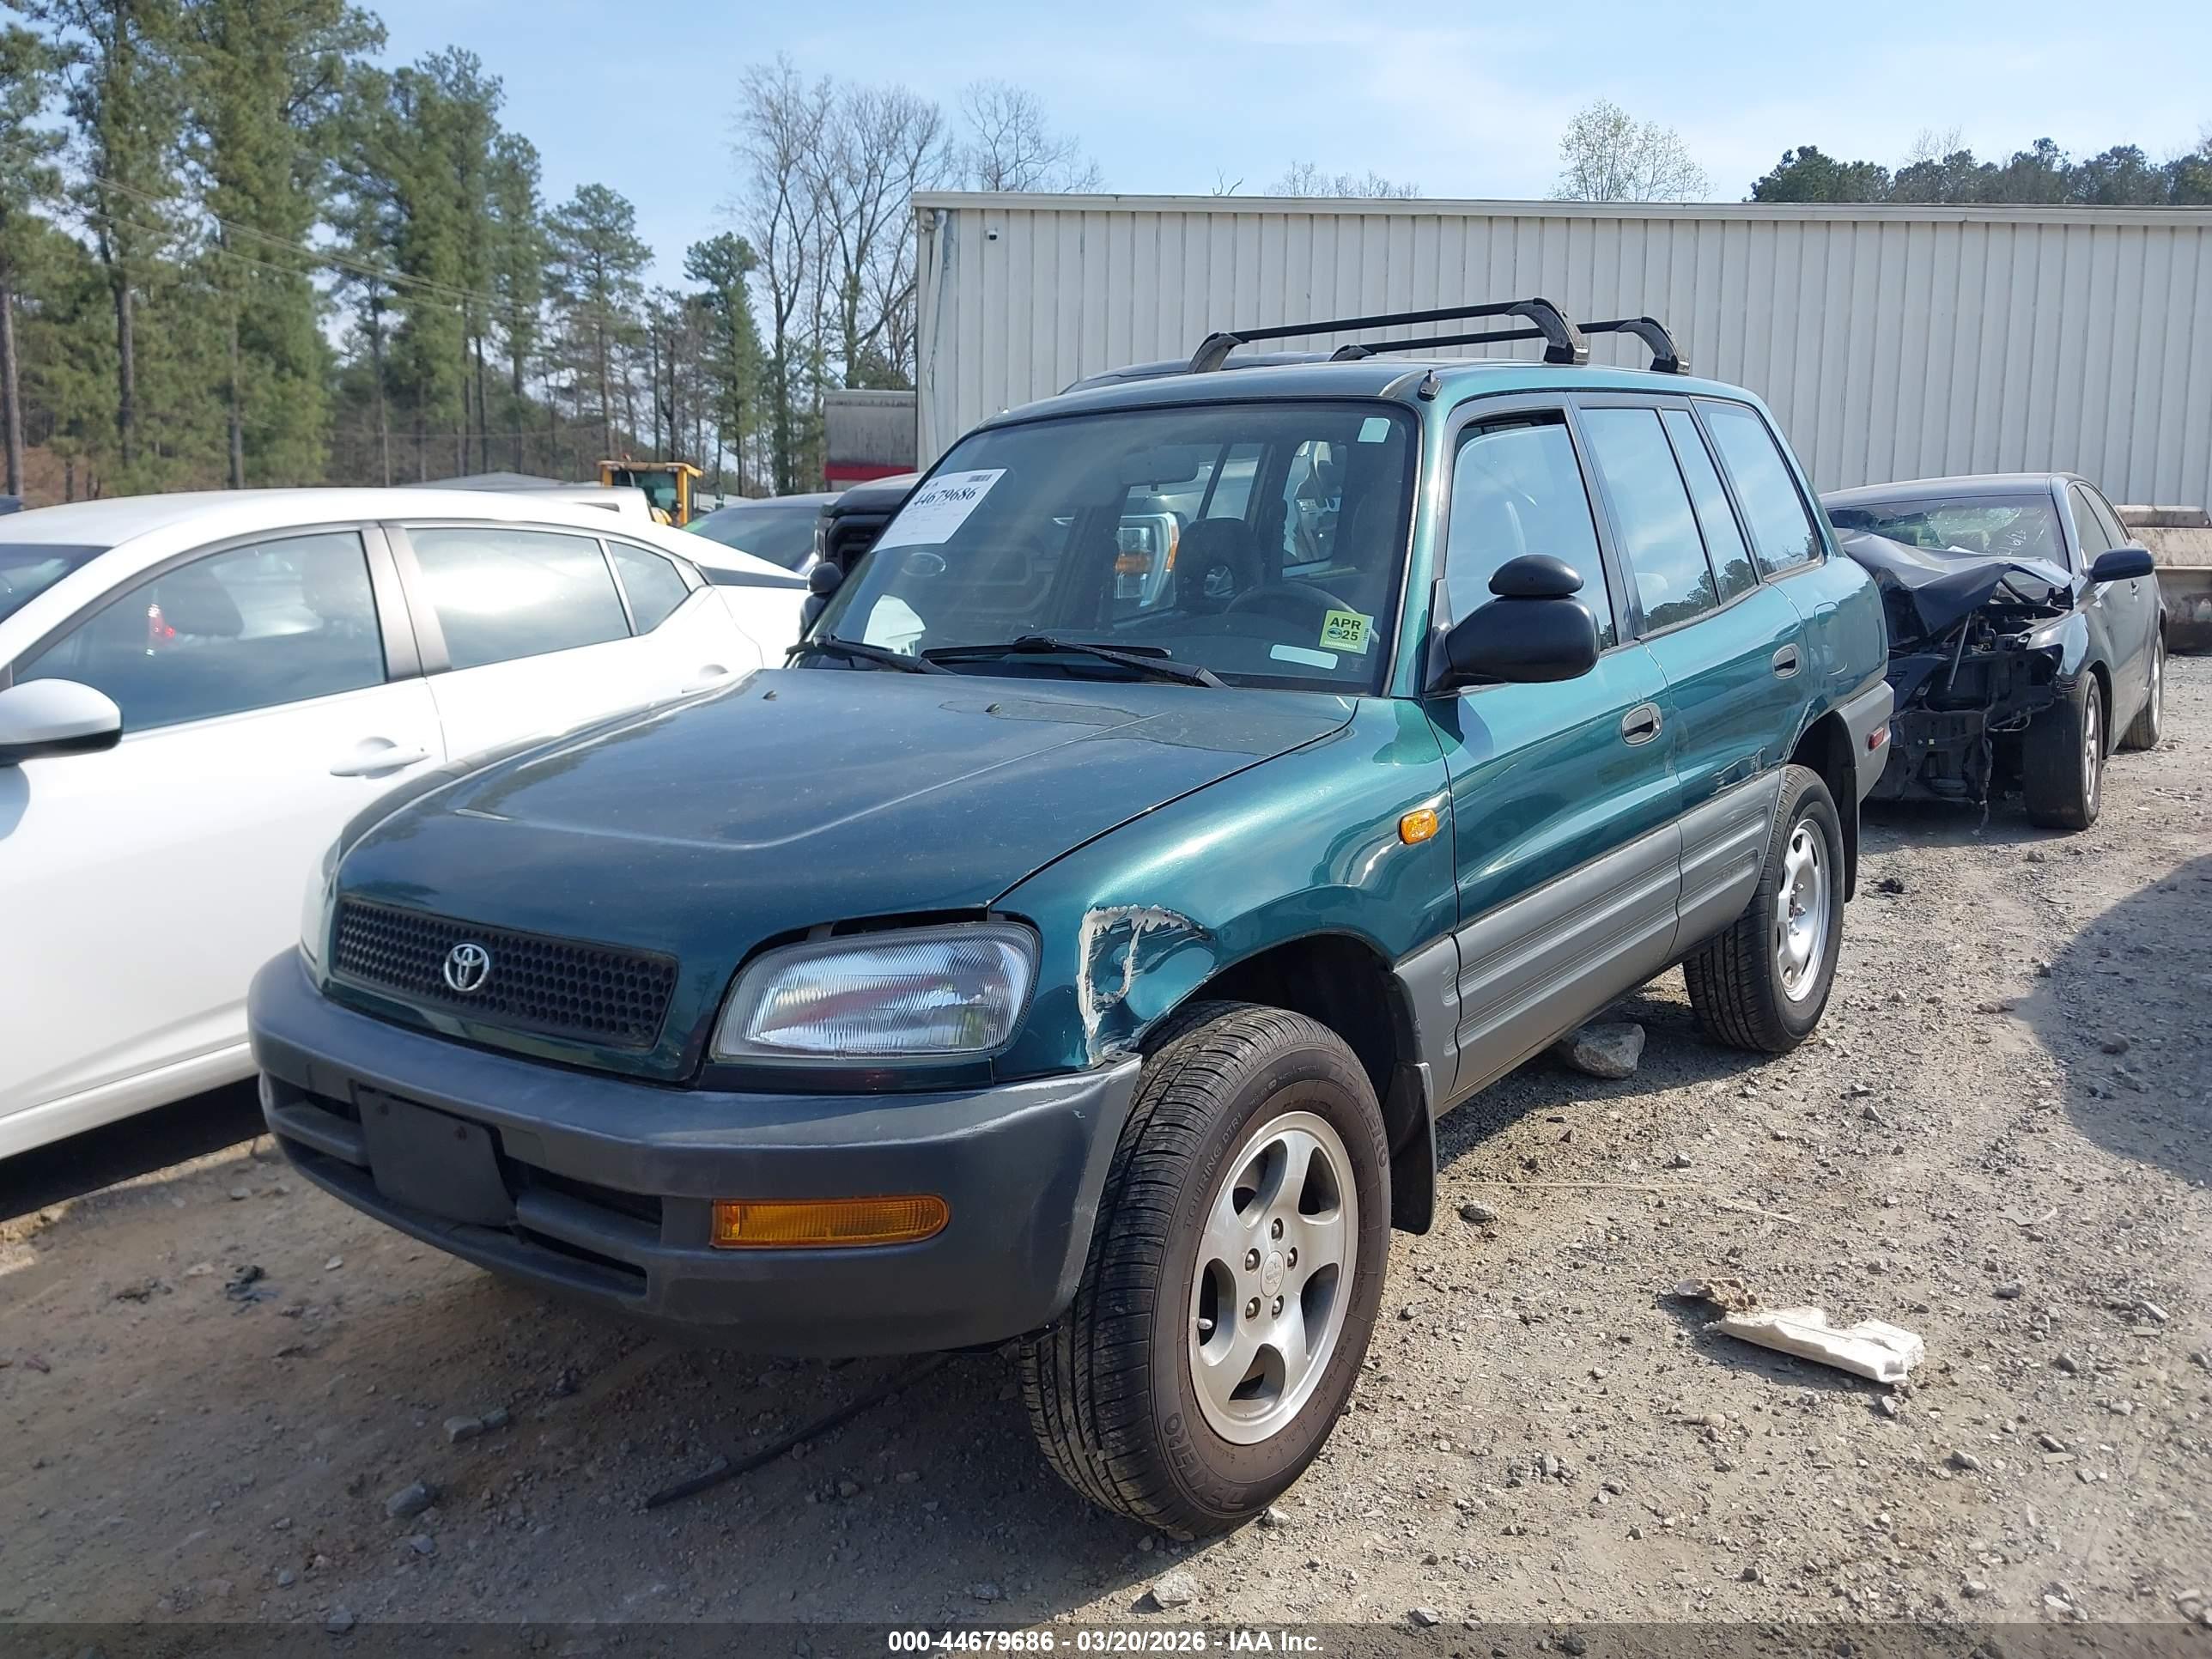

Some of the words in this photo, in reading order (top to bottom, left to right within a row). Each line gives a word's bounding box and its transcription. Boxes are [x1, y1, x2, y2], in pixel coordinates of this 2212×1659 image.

[914, 487, 980, 506] 44679686
[1329, 617, 1362, 630] APR
[1341, 629, 1359, 641] 25
[1182, 1142, 1223, 1230] TOURING
